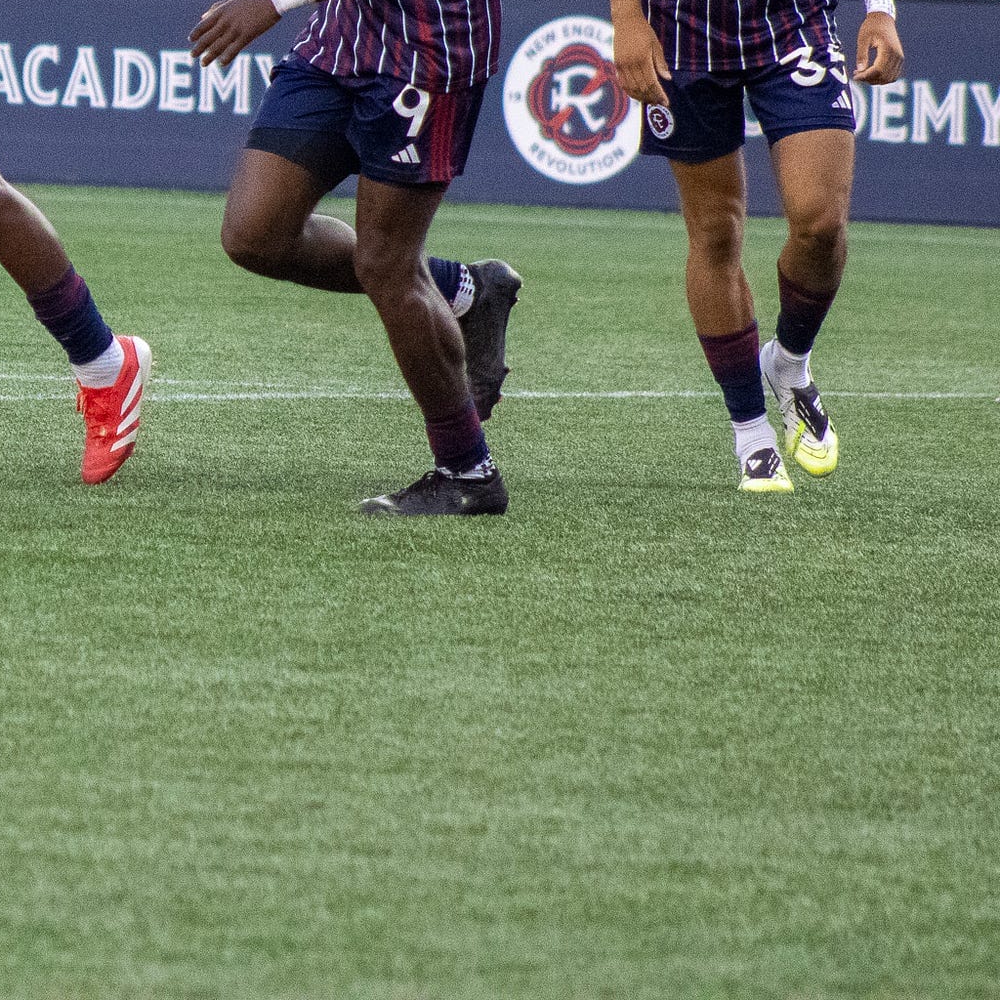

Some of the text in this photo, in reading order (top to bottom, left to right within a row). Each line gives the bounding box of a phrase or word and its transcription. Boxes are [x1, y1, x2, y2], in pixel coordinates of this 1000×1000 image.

[562, 24, 614, 45] ENGL
[392, 83, 430, 137] 9
[530, 141, 625, 176] REVOLUTION
